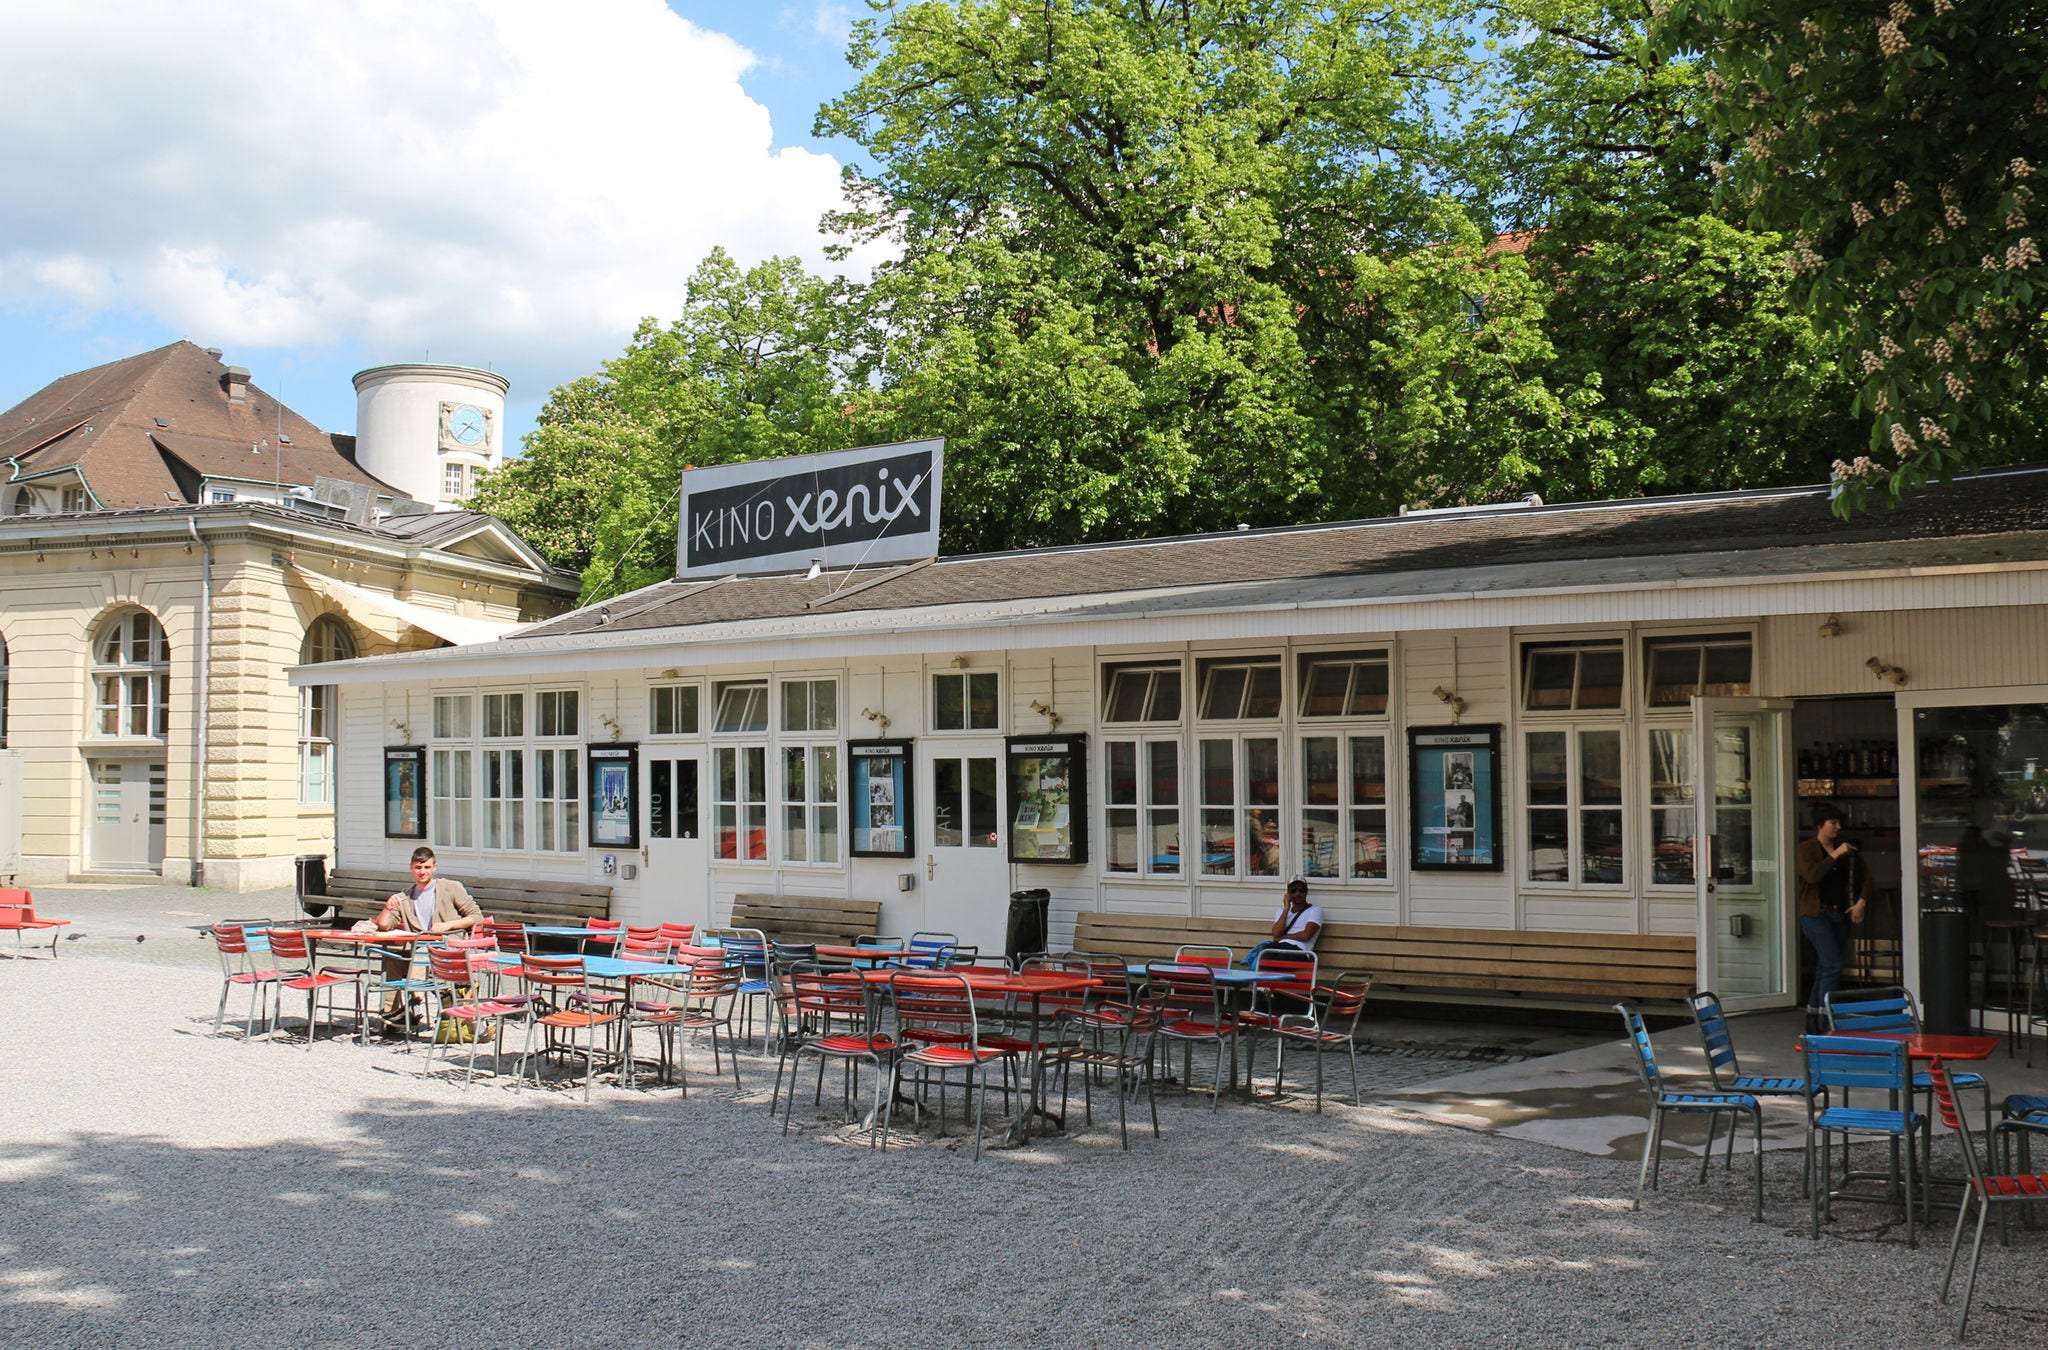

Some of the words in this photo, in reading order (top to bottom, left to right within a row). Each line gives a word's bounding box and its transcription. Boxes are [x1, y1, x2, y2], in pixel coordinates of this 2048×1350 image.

[696, 500, 775, 552] KINO
[785, 467, 921, 537] xenix
[651, 793, 662, 837] KINO
[936, 806, 950, 845] BAR
